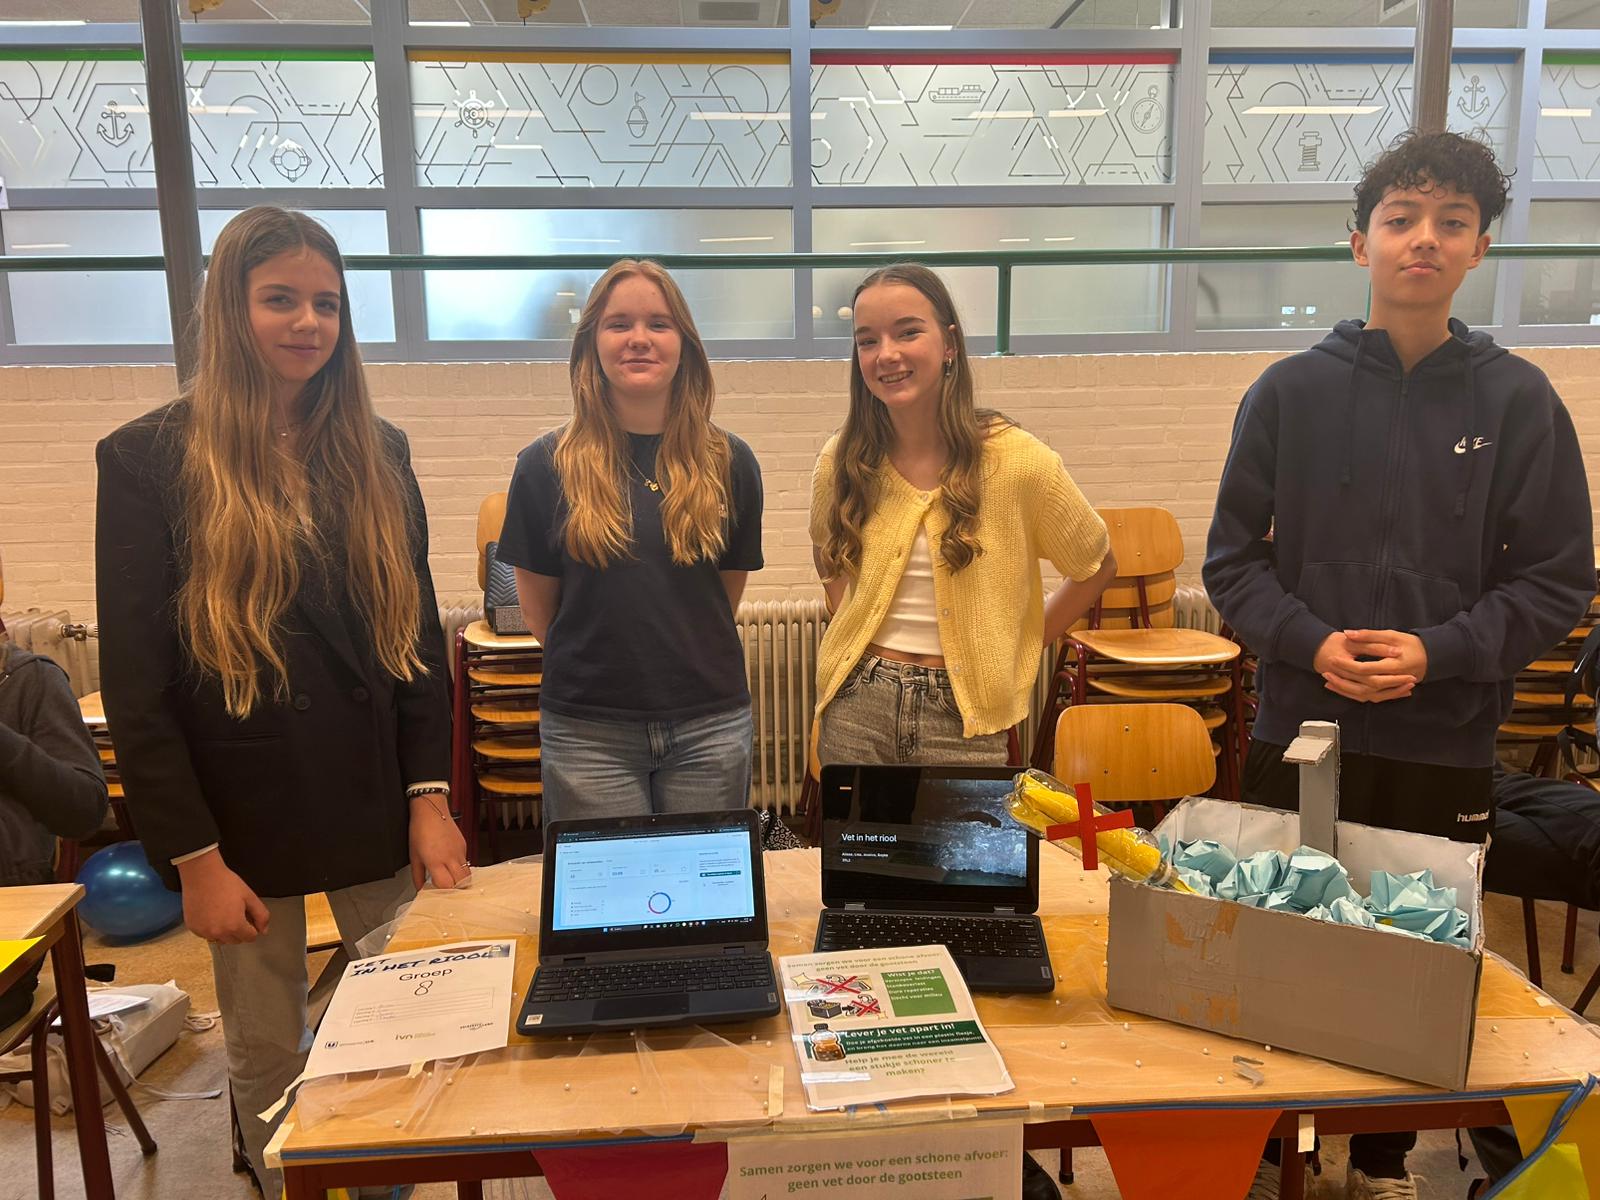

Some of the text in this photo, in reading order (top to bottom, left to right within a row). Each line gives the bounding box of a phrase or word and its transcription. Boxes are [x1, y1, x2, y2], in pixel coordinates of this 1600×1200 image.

[841, 832, 897, 842] Vet in het riool
[350, 952, 491, 977] IN HET RIOOL
[353, 958, 391, 969] VET
[399, 968, 453, 981] Groep
[414, 980, 434, 996] 8
[844, 1030, 875, 1038] Lever
[877, 1028, 887, 1037] je
[909, 1024, 940, 1033] apart
[870, 1062, 902, 1070] stukje
[903, 1057, 943, 1066] schoner
[886, 1067, 926, 1077] maken?
[740, 1149, 1009, 1177] Samen zorgen we voor een schone afvoer:
[788, 1169, 963, 1193] geen vet door de gootsteen
